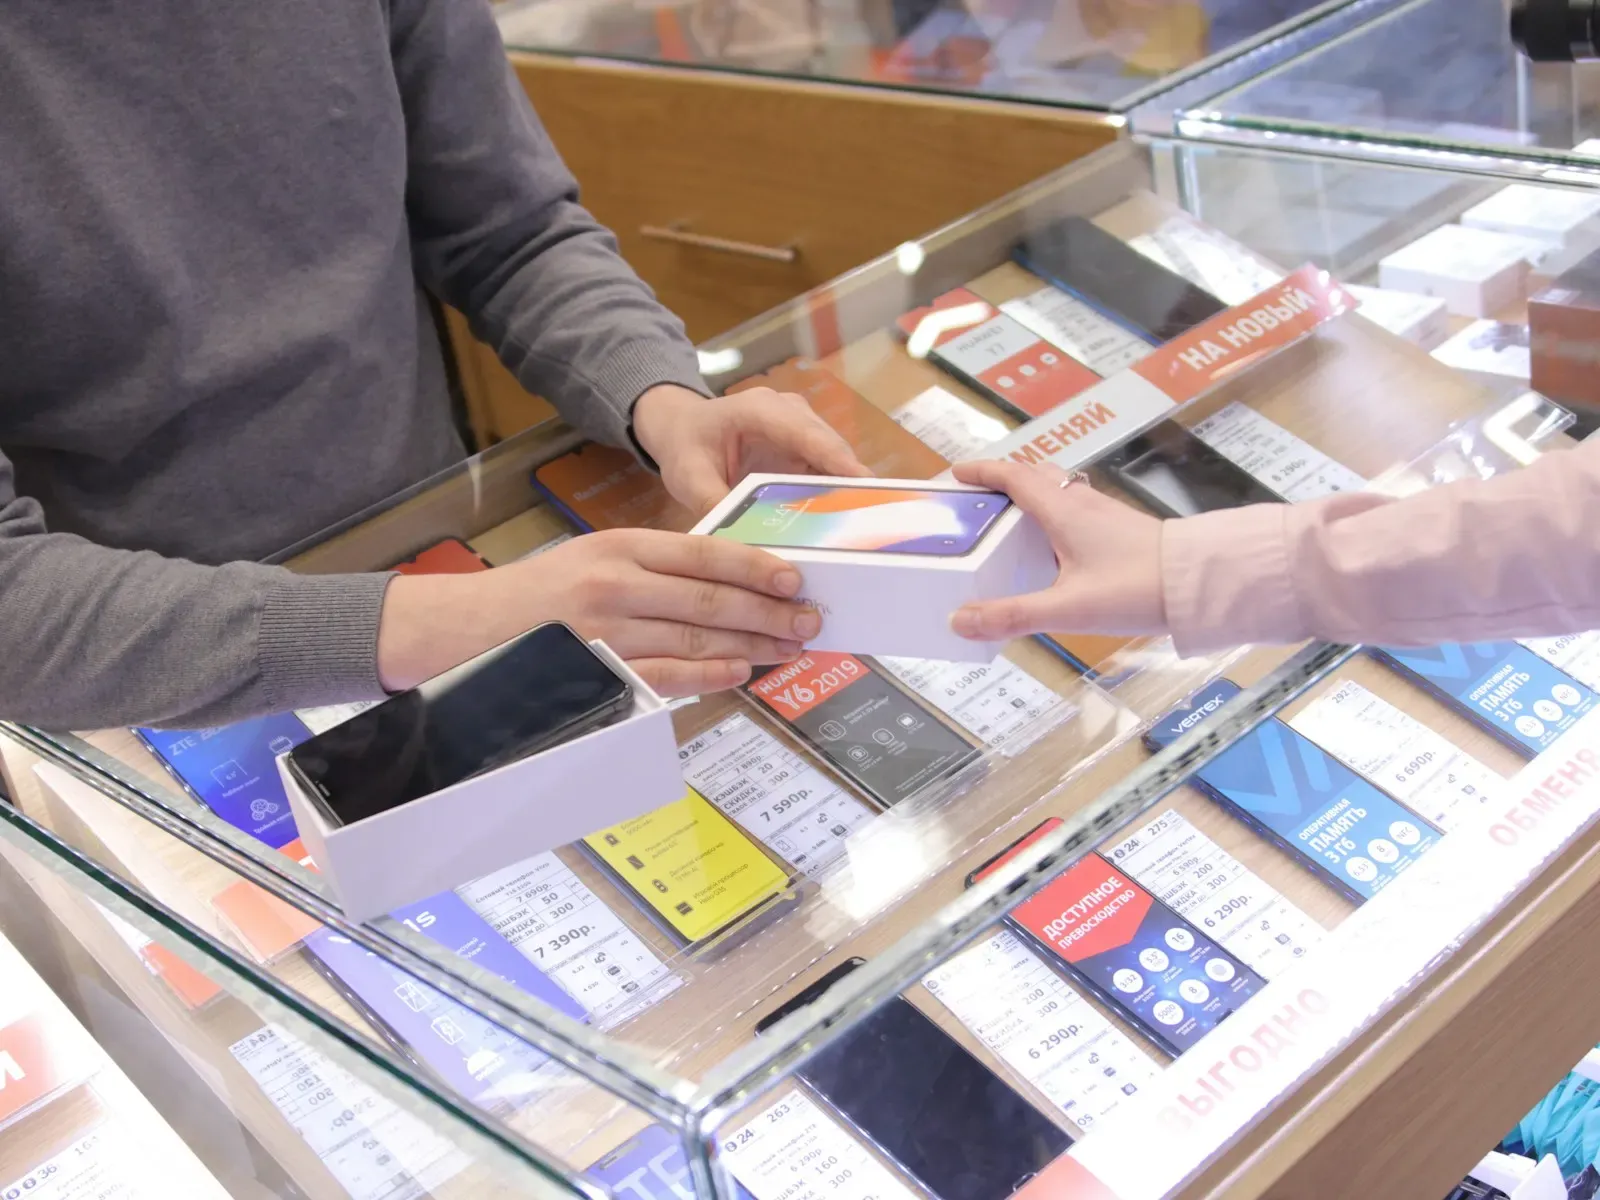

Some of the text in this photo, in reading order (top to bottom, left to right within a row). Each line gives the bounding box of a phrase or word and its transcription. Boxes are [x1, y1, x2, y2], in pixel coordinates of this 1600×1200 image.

[1178, 340, 1229, 371] НА
[1218, 284, 1317, 349] НОВЫЙ
[758, 656, 816, 694] HUAWEI
[771, 683, 816, 712] Y6
[810, 659, 860, 696] 2019
[944, 685, 955, 697] 8
[956, 664, 993, 692] 090р.
[1469, 664, 1515, 701] ОПЕРАТИВНАЯ
[1479, 671, 1530, 712] ПАМЯТЬ
[1331, 689, 1350, 705] 292
[1171, 695, 1224, 734] VERTEX
[1494, 710, 1511, 722] 3
[168, 736, 198, 757] ZTE
[690, 740, 702, 753] 24
[1395, 772, 1406, 783] 6
[1403, 749, 1437, 777] 690р.
[713, 763, 773, 803] КЭШБЭК 20
[723, 785, 757, 811] СКИДКА
[768, 771, 789, 787] 300
[760, 810, 771, 822] 7
[772, 788, 814, 816] 590р.
[1299, 798, 1351, 841] ОПЕРАТИВНАЯ
[1123, 819, 1168, 853] 24 275
[1178, 834, 1197, 850] Vertex
[1308, 806, 1368, 853] ПАМЯТЬ
[1192, 863, 1214, 879] 200
[1324, 851, 1341, 864] 3
[1206, 874, 1227, 890] 300
[541, 892, 559, 906] 50
[548, 902, 575, 920] 300
[1042, 875, 1124, 941] ДОСТУПНОЕ
[1203, 917, 1216, 928] 6
[1213, 893, 1253, 921] 290р.
[1058, 888, 1136, 950] ПРЕВОСХОДСТВО
[533, 946, 545, 960] 7
[547, 923, 597, 955] 390р.
[1170, 931, 1186, 943] 16
[1022, 988, 1045, 1005] 200
[1189, 986, 1198, 995] 8
[1036, 1000, 1058, 1018] 300
[1028, 1048, 1041, 1060] 6
[1039, 1022, 1084, 1052] 290р.
[736, 1104, 791, 1145] 24 263
[1076, 1113, 1094, 1127] OS
[37, 1163, 58, 1180] 36
[814, 1155, 839, 1176] 160
[828, 1168, 853, 1191] 300
